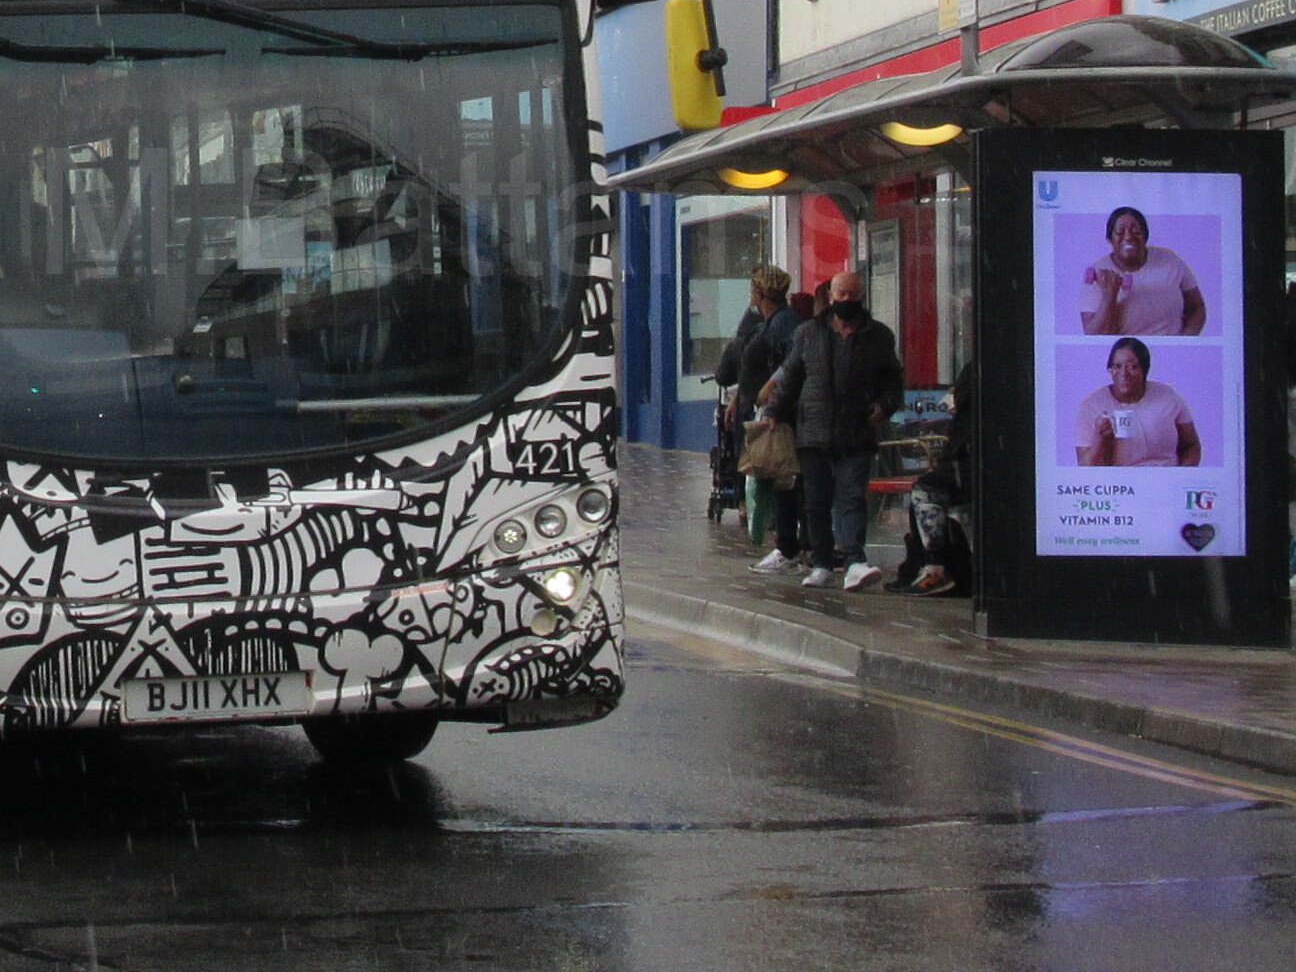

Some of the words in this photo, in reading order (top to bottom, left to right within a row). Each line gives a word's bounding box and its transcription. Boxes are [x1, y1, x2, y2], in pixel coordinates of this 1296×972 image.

[1216, 8, 1250, 33] ITALIAN
[1137, 158, 1173, 167] Channel
[515, 441, 575, 475] 421
[1056, 485, 1090, 496] SAME
[1094, 485, 1135, 496] CUPPA
[1080, 501, 1112, 511] PLUS
[1059, 515, 1110, 526] VITAMIN
[1113, 515, 1134, 526] B12
[219, 677, 282, 709] XHX
